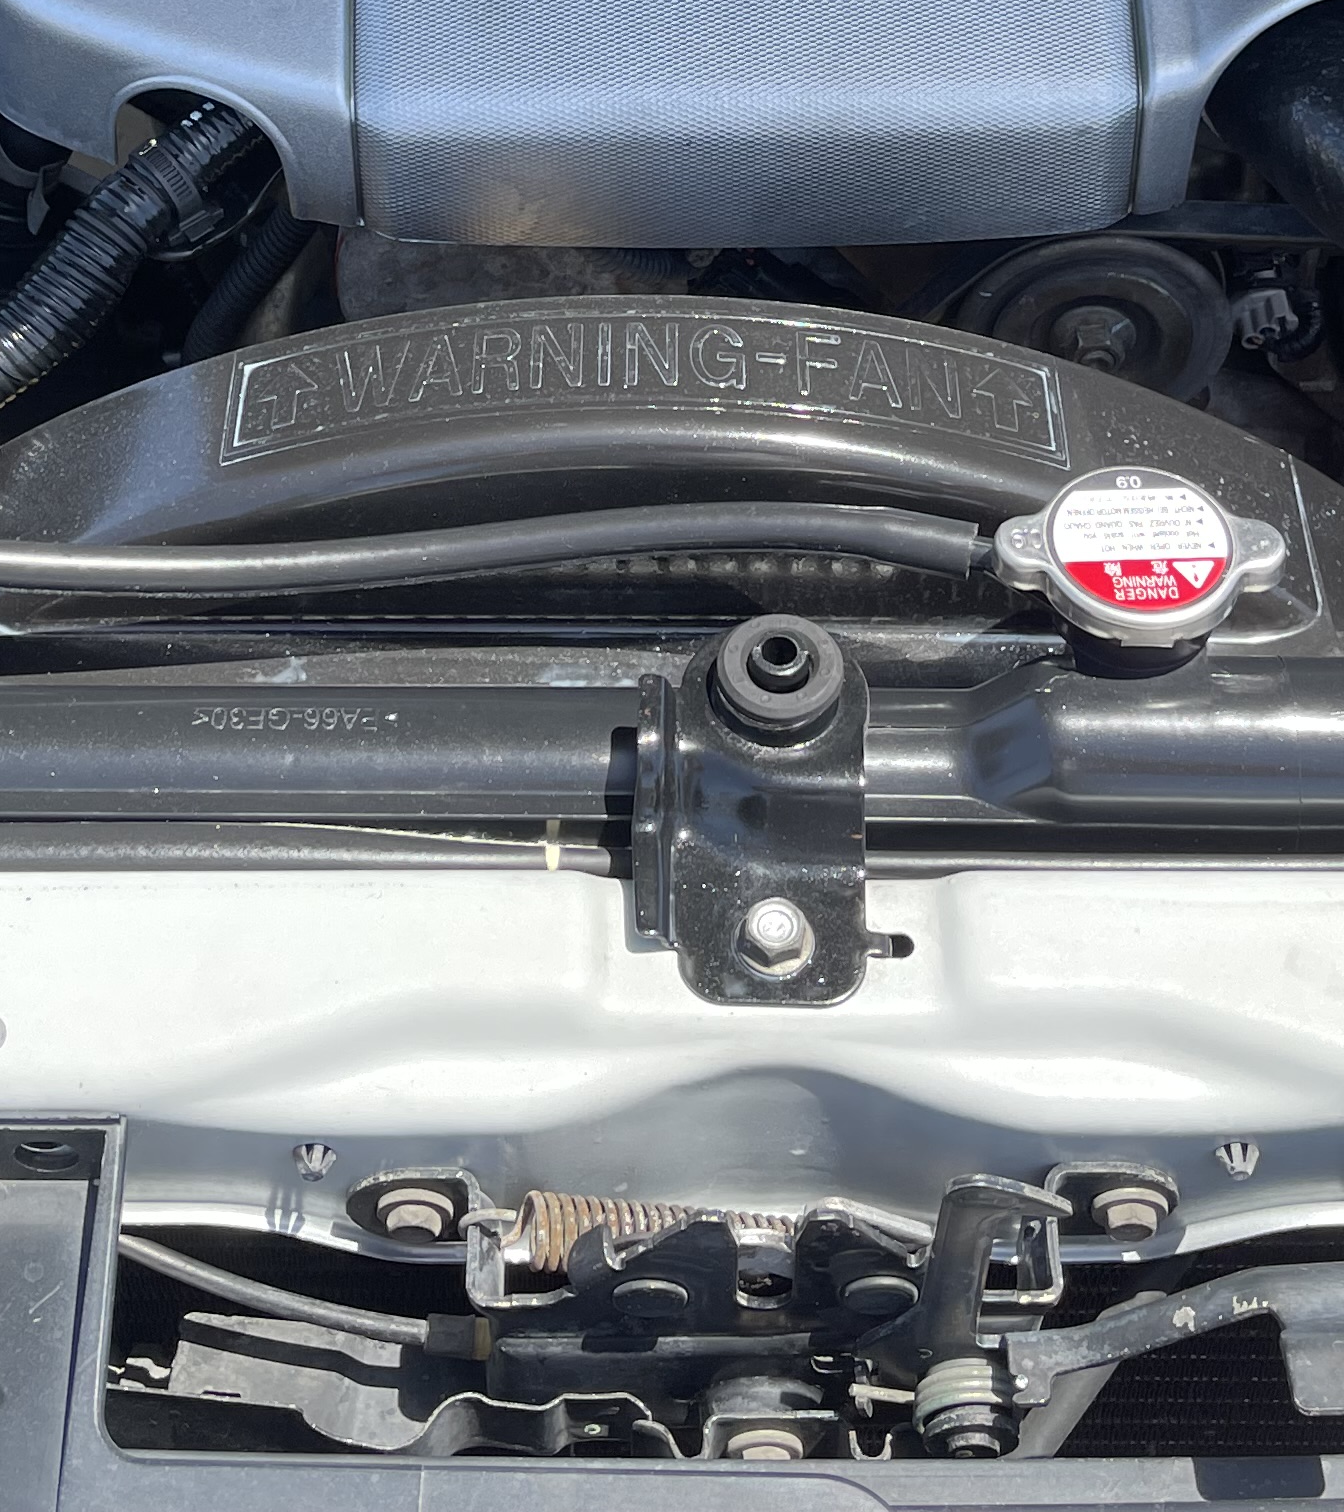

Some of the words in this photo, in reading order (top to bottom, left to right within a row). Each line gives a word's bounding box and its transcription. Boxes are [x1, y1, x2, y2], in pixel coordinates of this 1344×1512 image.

[334, 320, 963, 419] WARNING-FAN
[1115, 475, 1143, 489] 0.9
[1112, 574, 1178, 588] WARNING
[1114, 587, 1179, 601] DANGER
